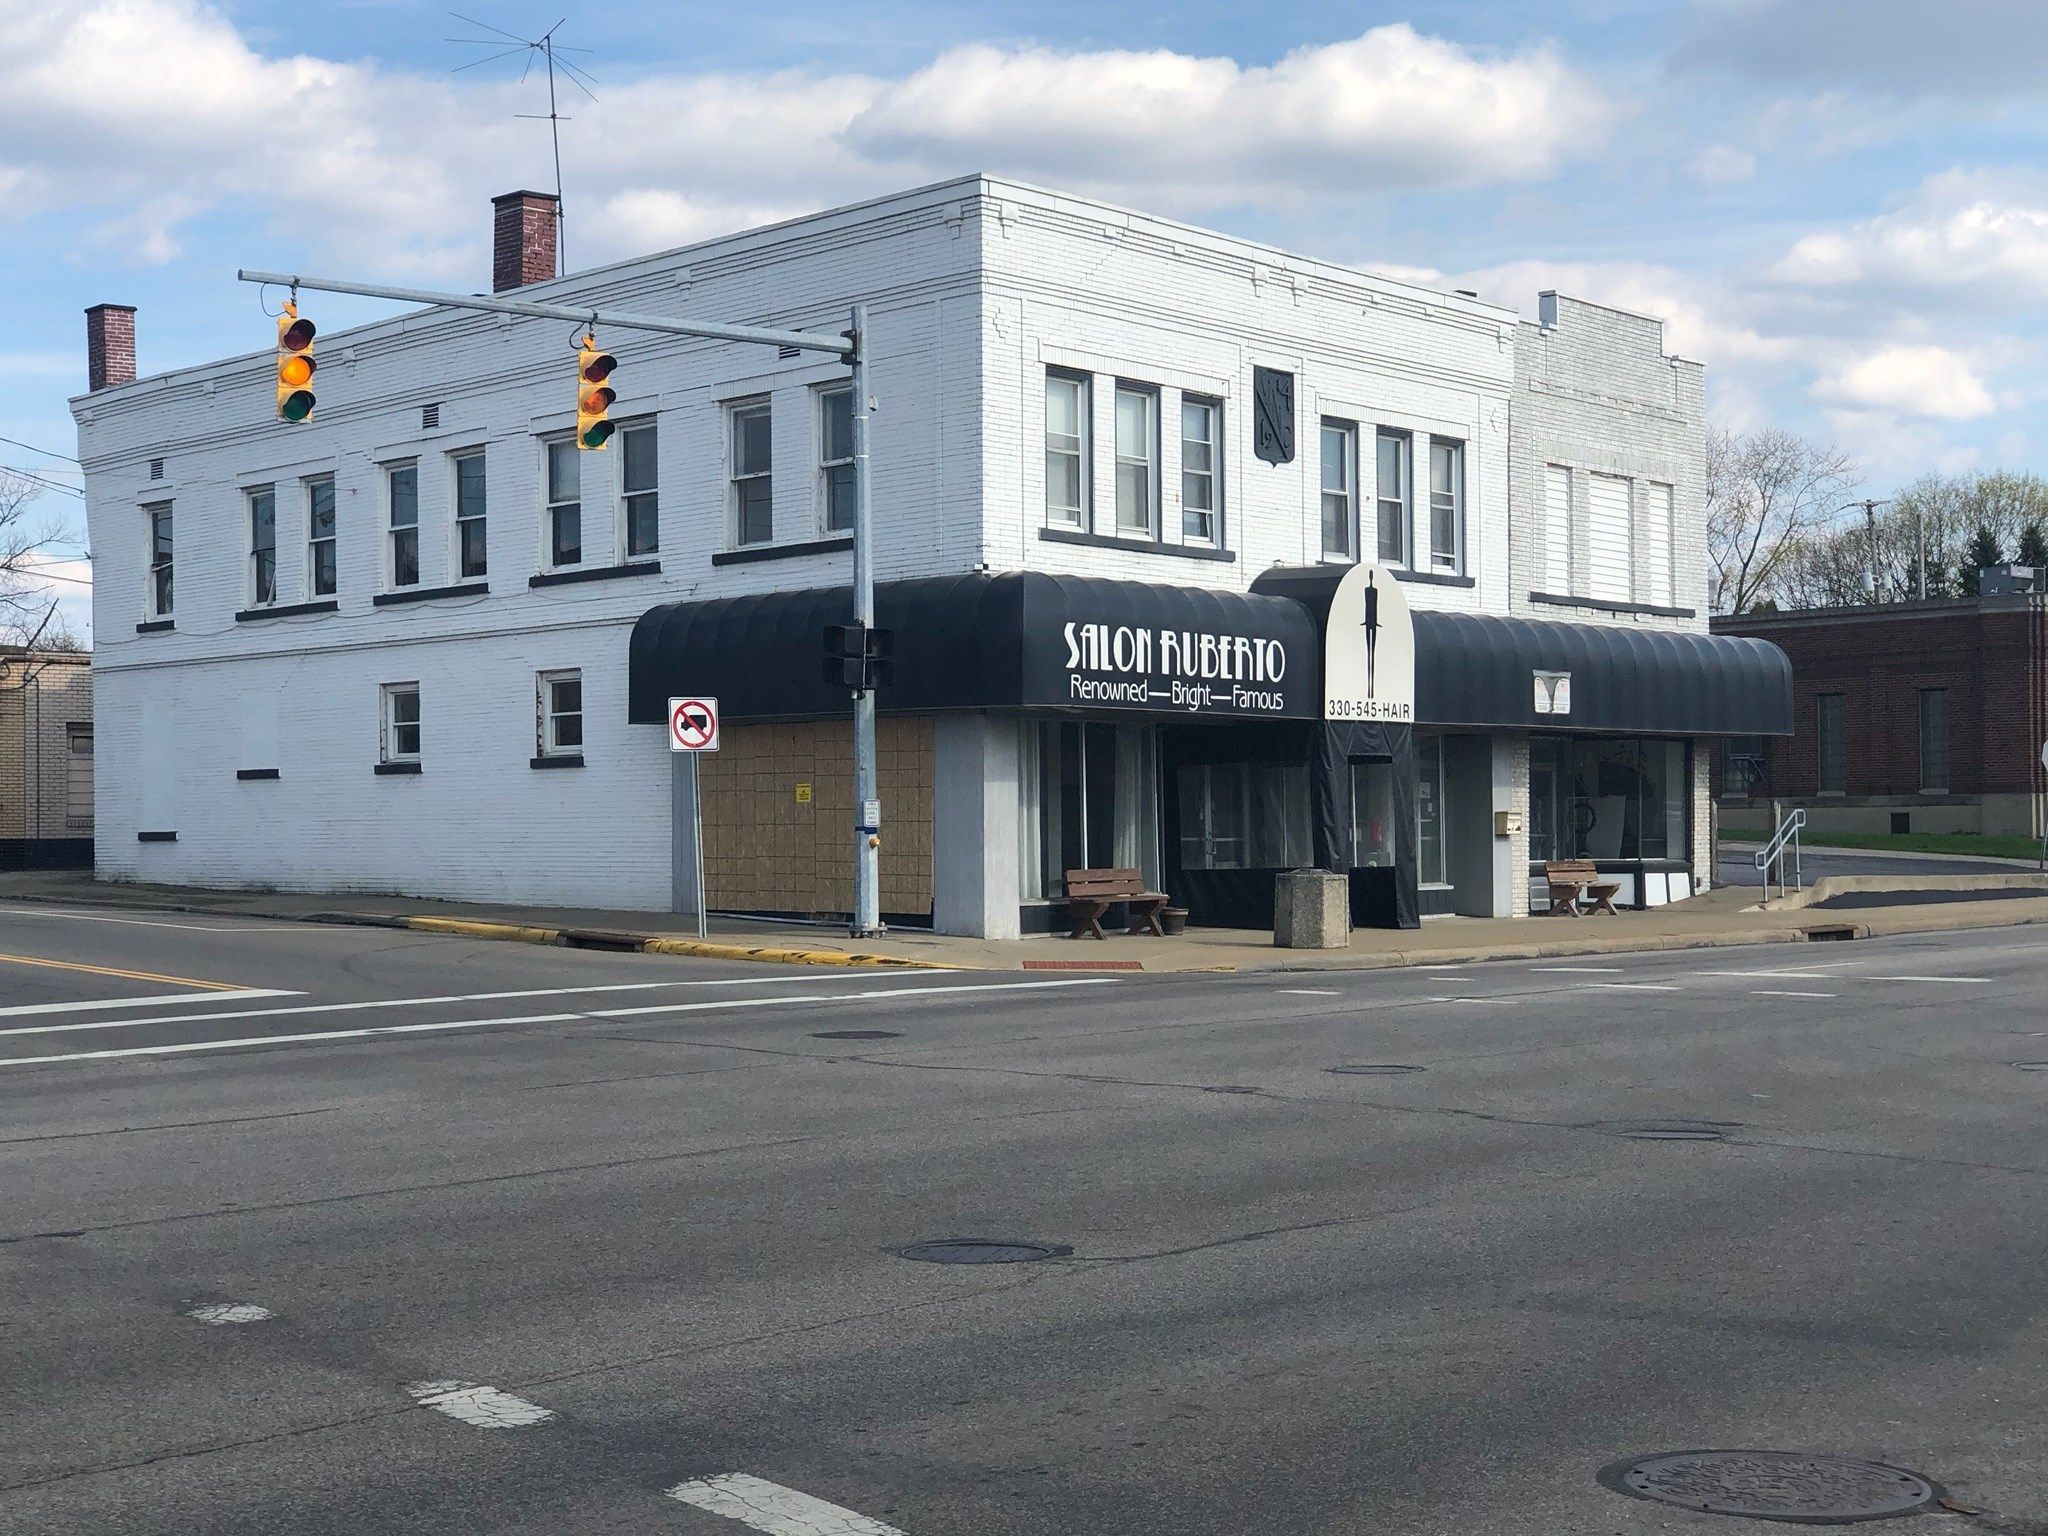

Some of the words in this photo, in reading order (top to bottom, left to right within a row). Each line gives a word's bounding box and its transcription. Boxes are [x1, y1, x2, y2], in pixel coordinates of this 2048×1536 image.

[1064, 622, 1151, 673] SALON
[1159, 629, 1285, 683] RUBERTO
[1070, 674, 1147, 702] Renowned
[1172, 680, 1211, 711] Bright
[1232, 684, 1284, 710] Famous
[1329, 700, 1410, 719] 330-545-HAIR
